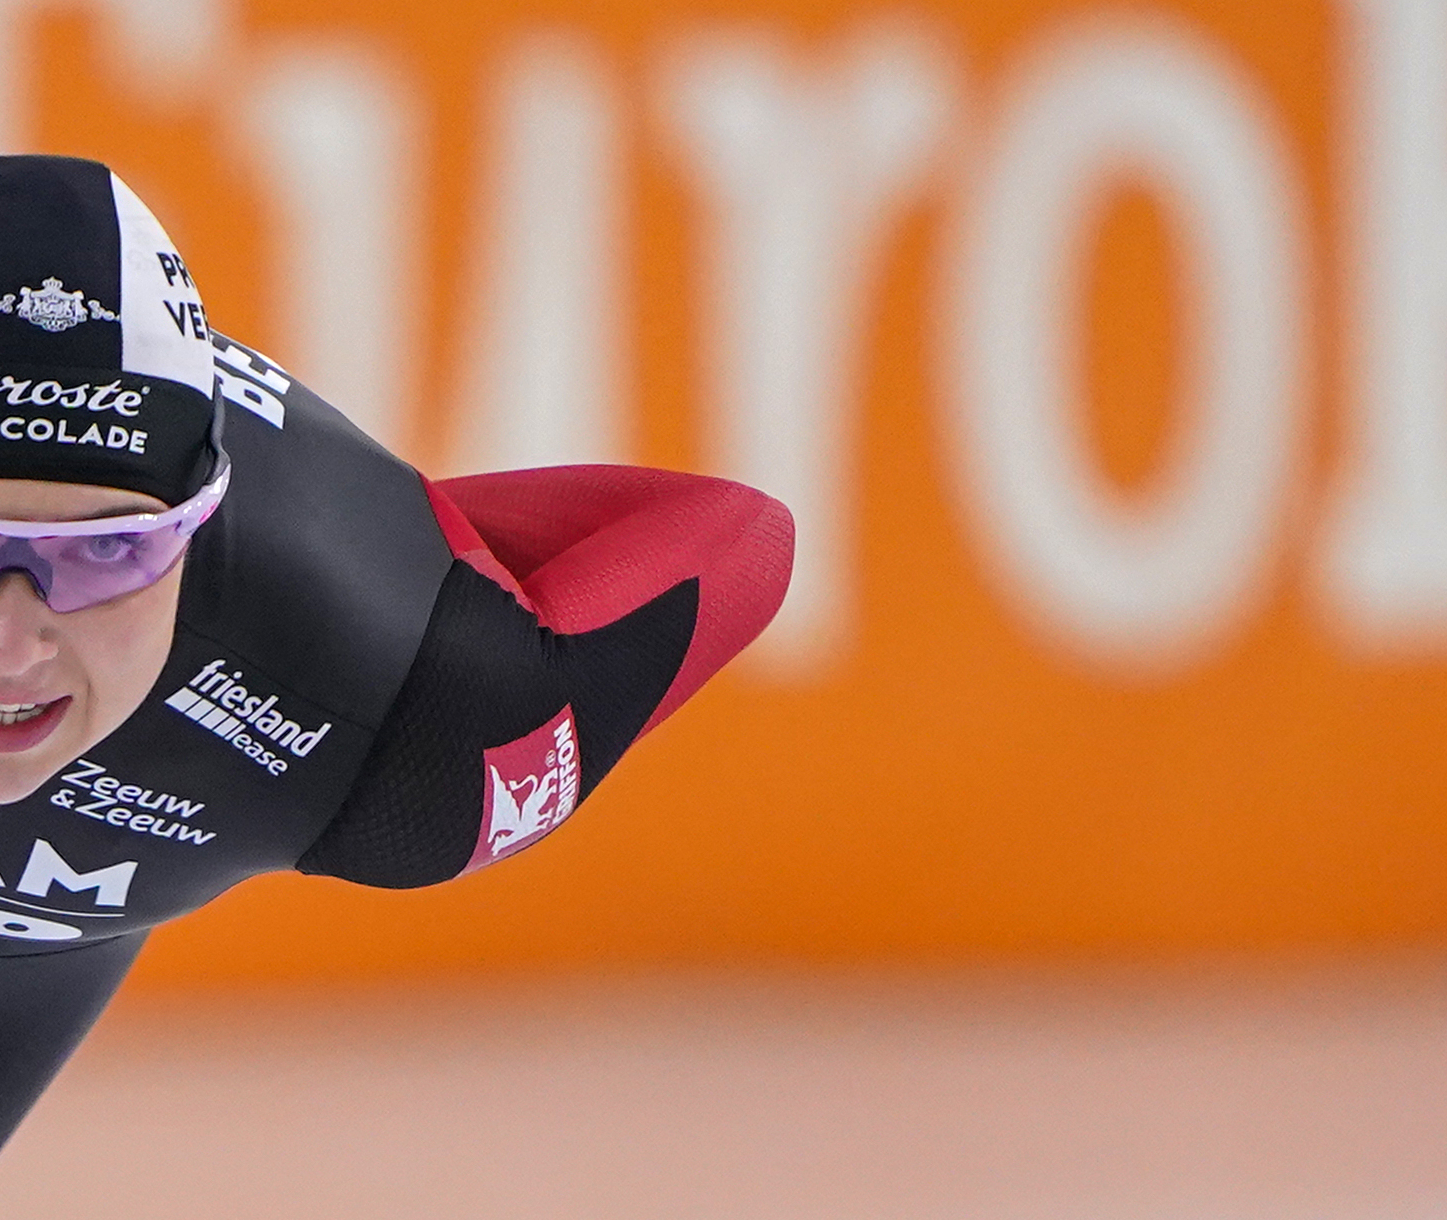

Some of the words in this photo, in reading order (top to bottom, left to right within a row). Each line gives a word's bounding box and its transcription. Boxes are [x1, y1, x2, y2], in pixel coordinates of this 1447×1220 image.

[188, 659, 332, 758] friesland
[224, 723, 289, 776] lease
[61, 758, 205, 818] Zeeuw
